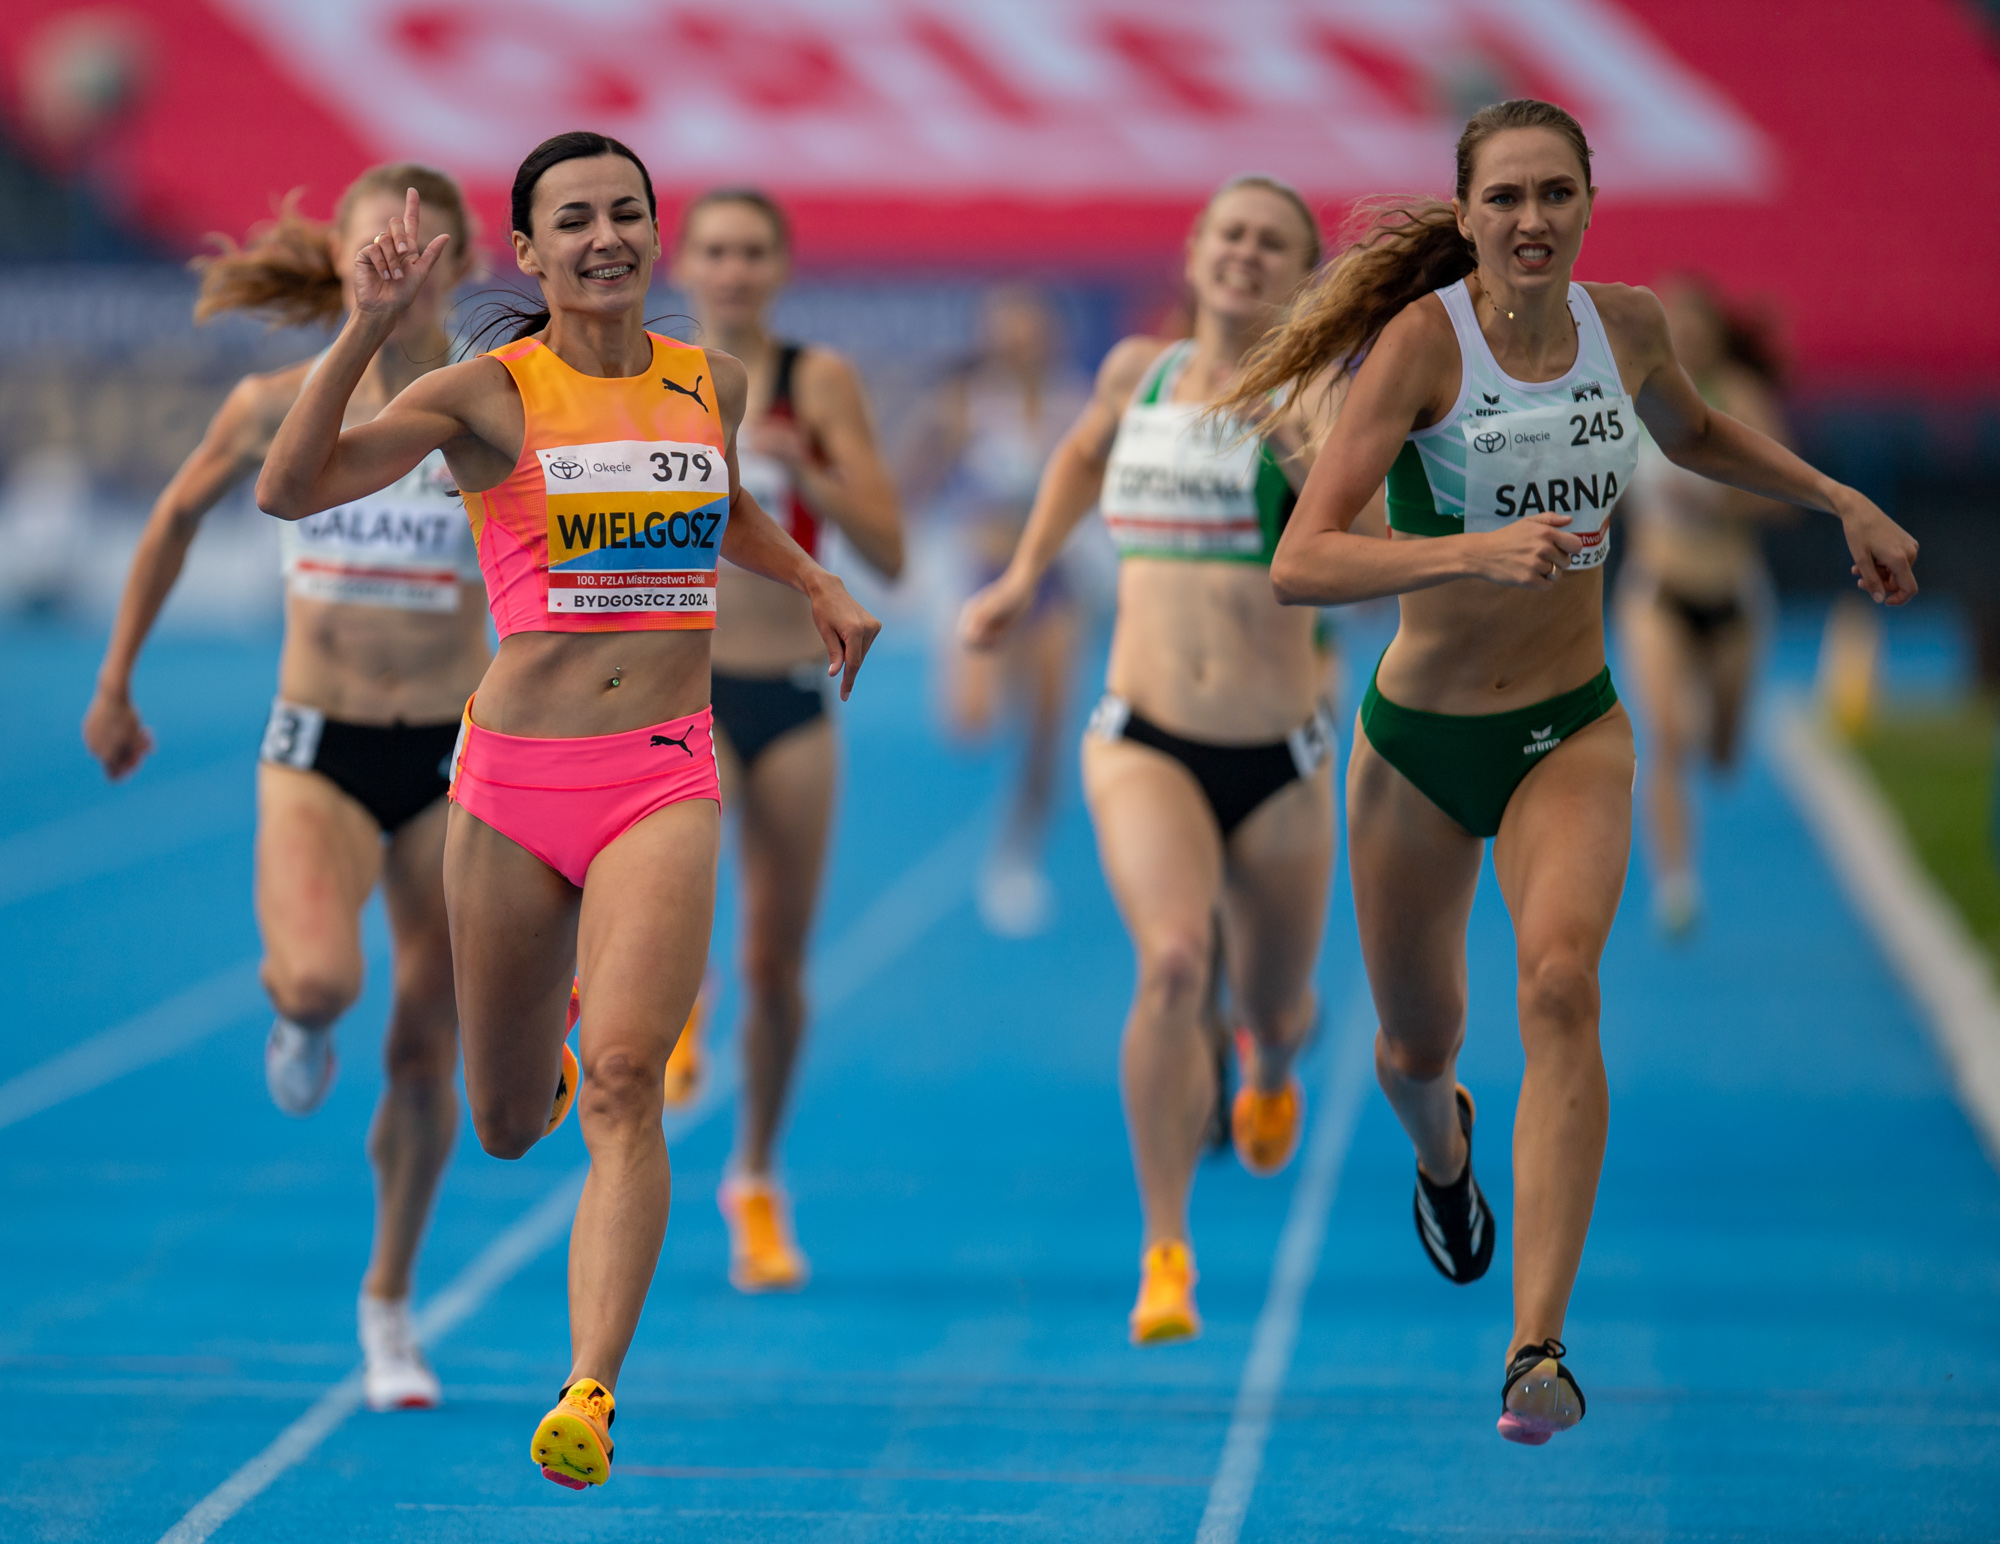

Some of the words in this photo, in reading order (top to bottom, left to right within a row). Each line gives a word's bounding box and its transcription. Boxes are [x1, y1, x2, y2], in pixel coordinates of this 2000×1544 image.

[1475, 407, 1508, 416] erim
[1570, 409, 1624, 447] 245
[1514, 430, 1550, 444] Okęcie
[593, 462, 631, 474] Okęcie
[650, 451, 712, 482] 379
[1494, 471, 1618, 517] SARNA
[557, 511, 722, 549] WIELGOSZ
[577, 575, 597, 586] 100.
[600, 575, 624, 586] PZLA
[626, 574, 686, 585] Mistrzostwa
[687, 574, 705, 584] Polski
[574, 594, 675, 608] BYDGOSZCZ
[679, 593, 708, 606] 2024
